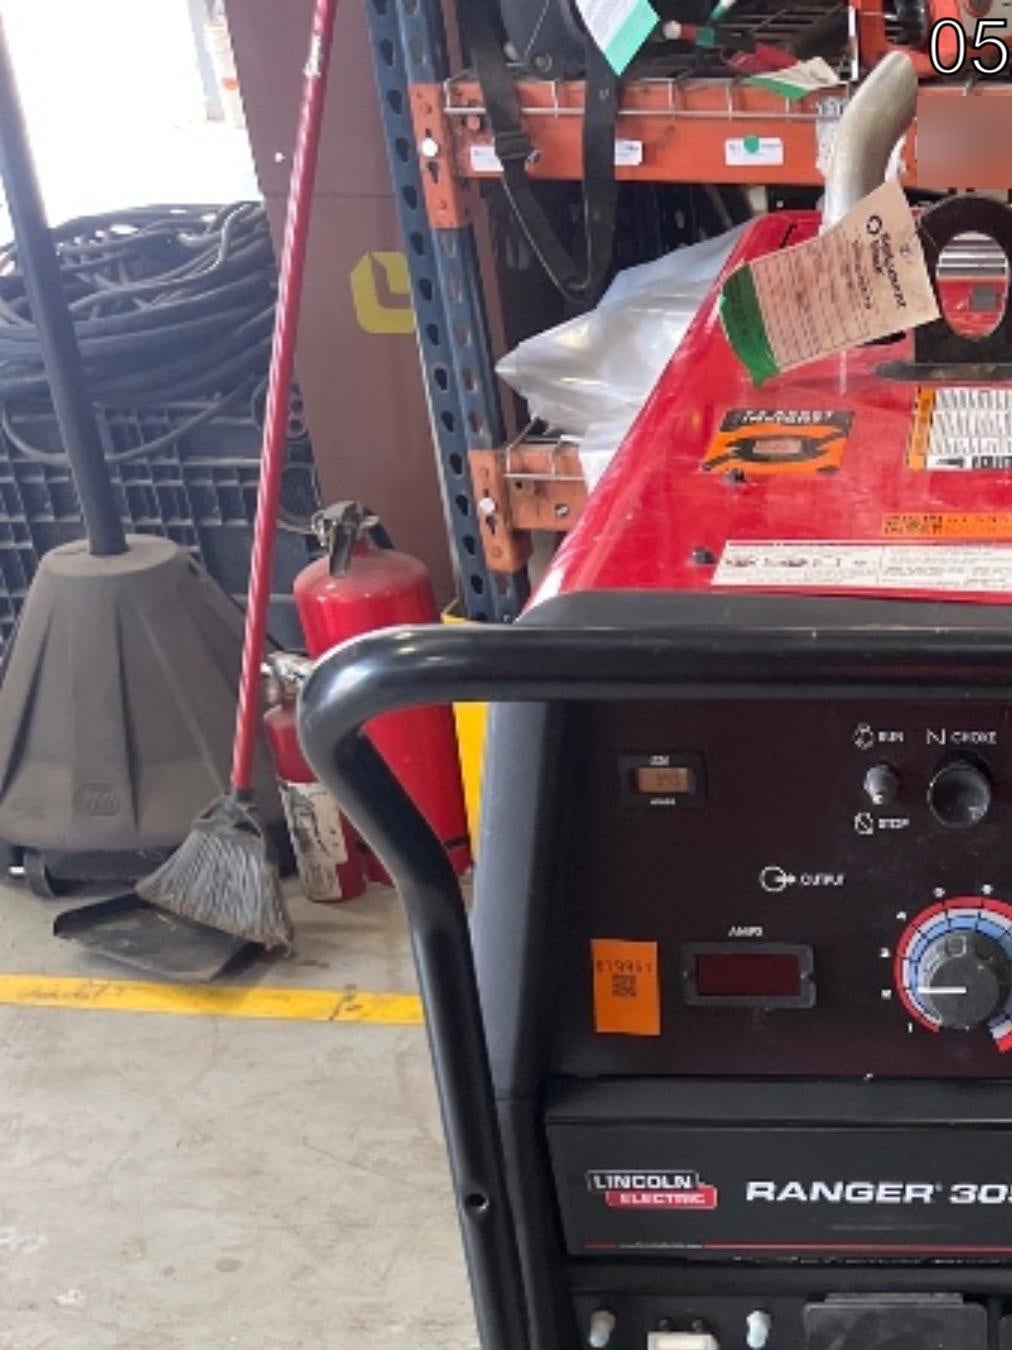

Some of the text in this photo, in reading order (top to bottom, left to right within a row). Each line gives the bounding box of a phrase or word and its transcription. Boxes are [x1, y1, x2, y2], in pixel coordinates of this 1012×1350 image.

[593, 1174, 692, 1190] LINCOLN
[620, 1192, 706, 1205] ELECTRIC
[745, 1181, 935, 1204] RANGER
